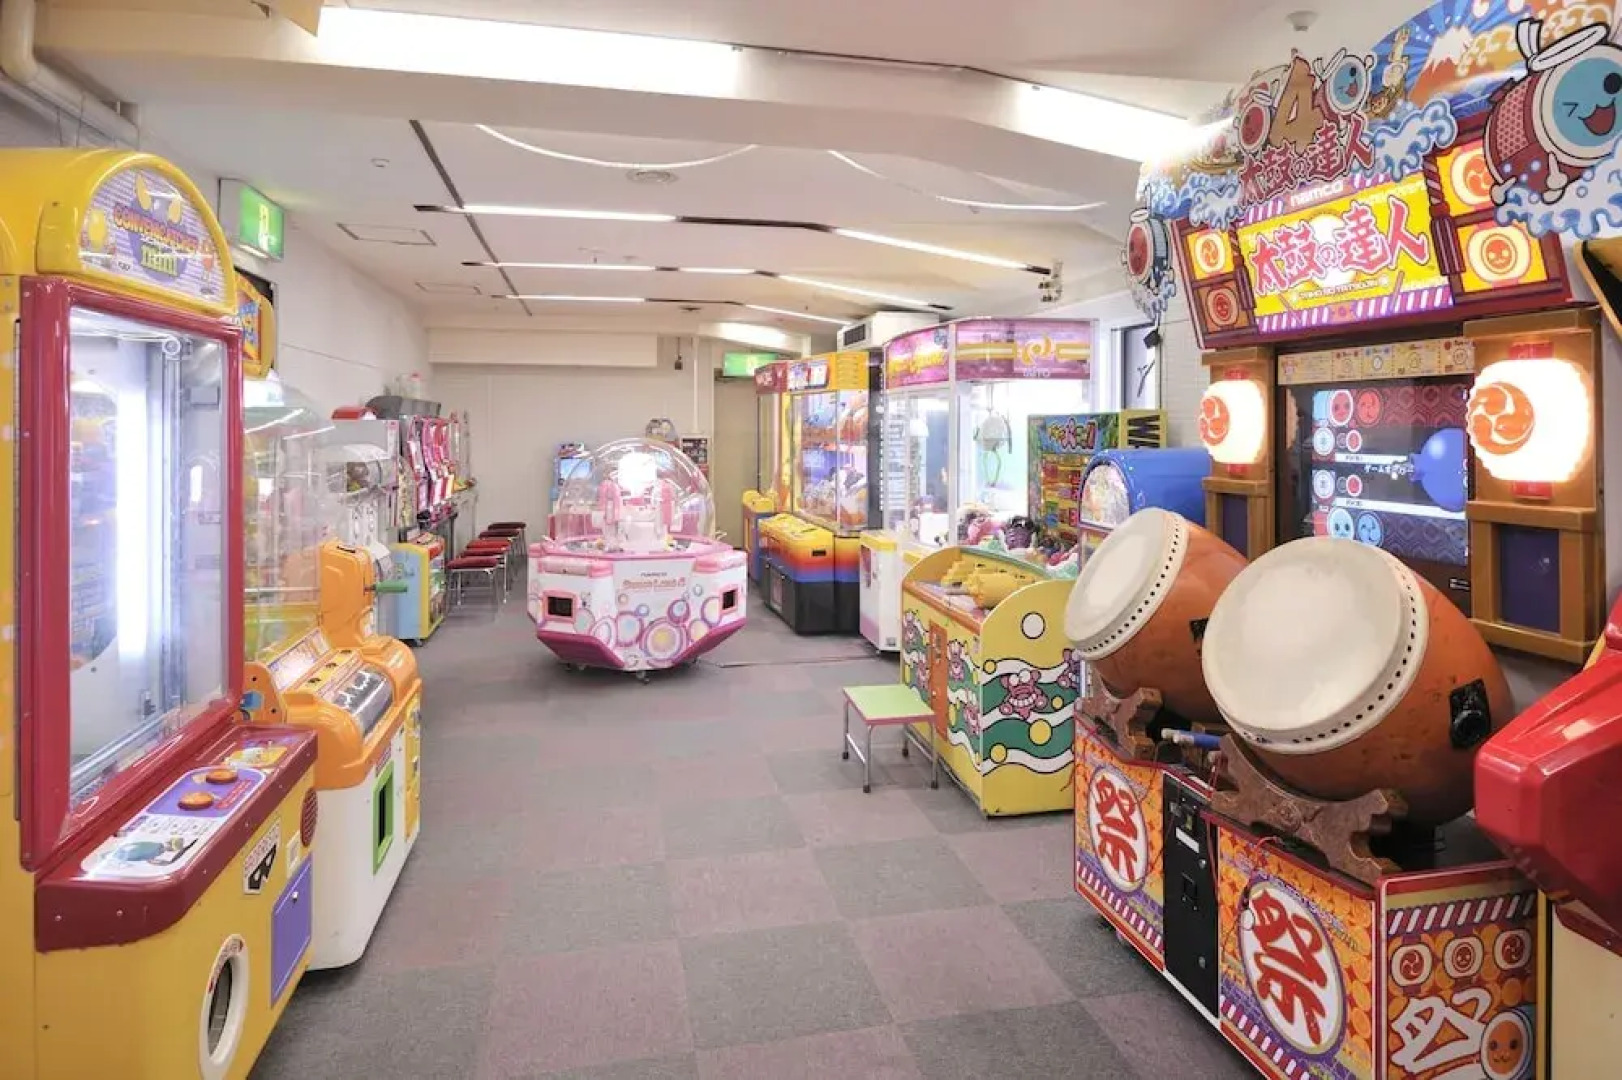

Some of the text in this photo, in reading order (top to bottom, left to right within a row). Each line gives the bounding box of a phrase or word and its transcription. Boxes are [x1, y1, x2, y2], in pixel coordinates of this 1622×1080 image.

[1290, 180, 1344, 207] namco
[1250, 196, 1428, 296] 太鼓の達人
[1096, 775, 1138, 883] 祭
[1251, 889, 1328, 1045] 祭
